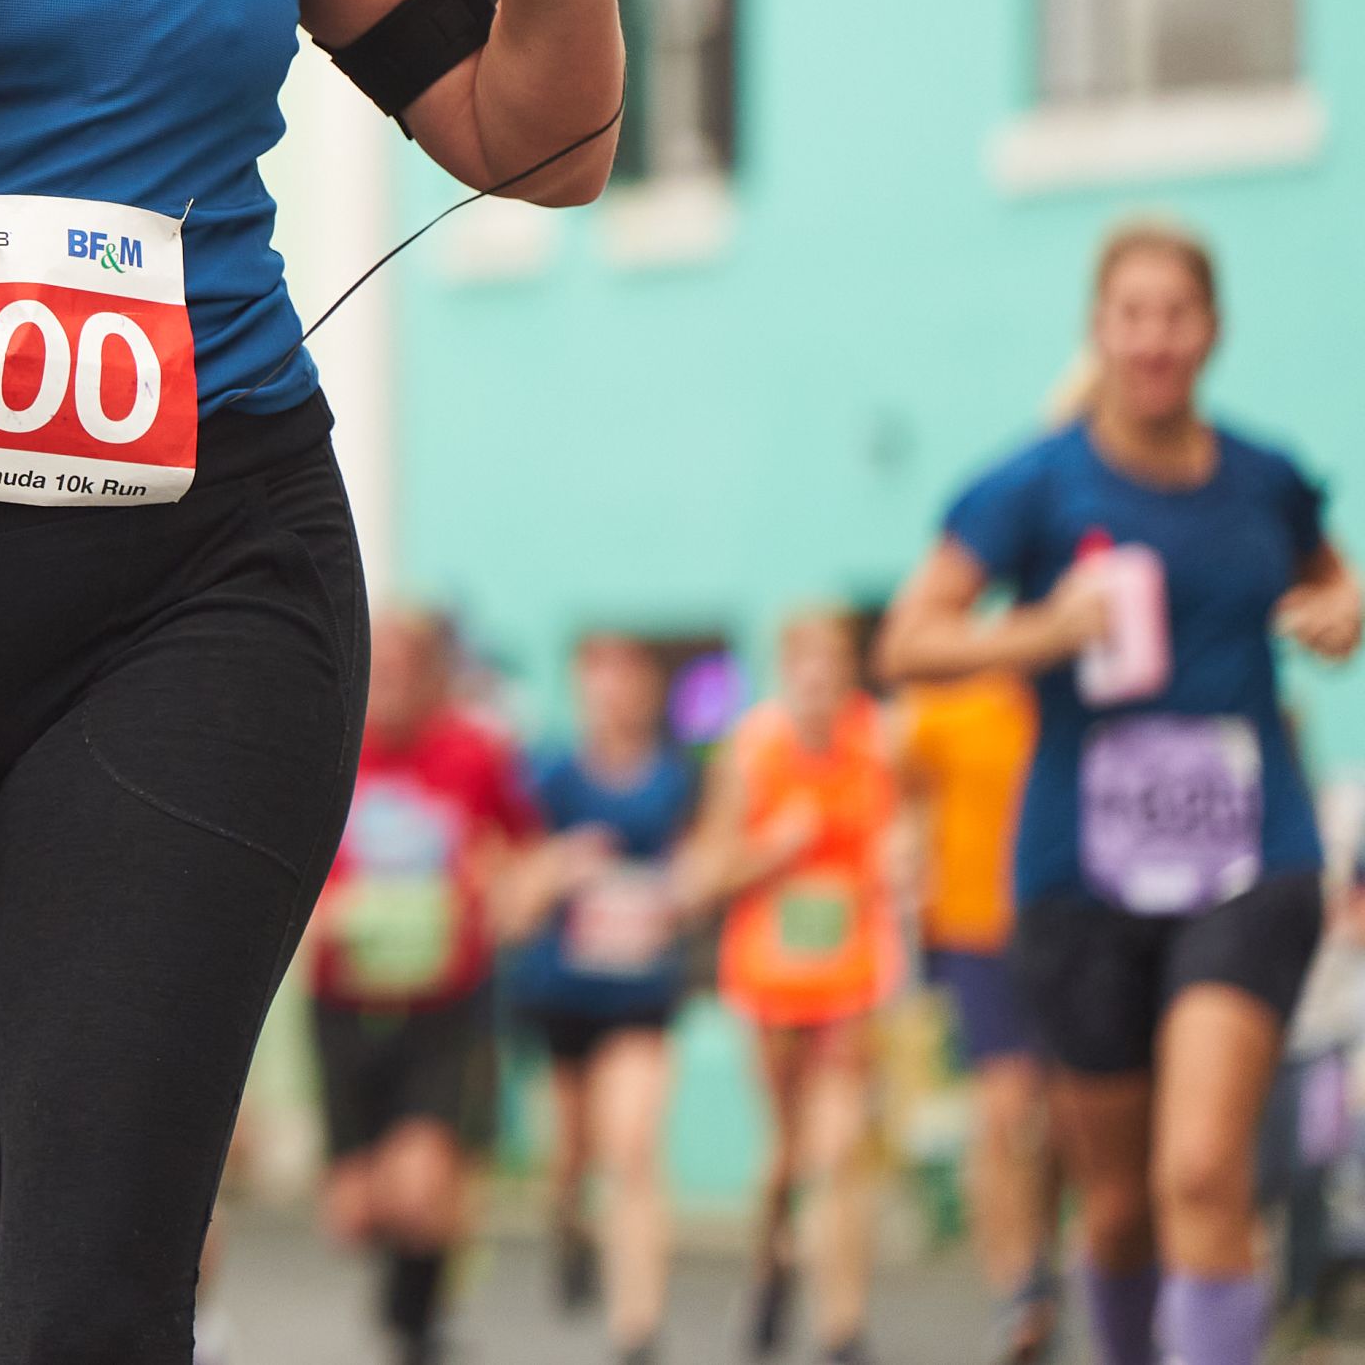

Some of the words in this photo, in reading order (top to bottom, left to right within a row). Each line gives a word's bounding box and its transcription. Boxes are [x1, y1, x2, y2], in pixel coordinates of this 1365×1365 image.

[67, 228, 143, 274] BF&M
[55, 473, 94, 495] 10k
[101, 478, 148, 497] Run
